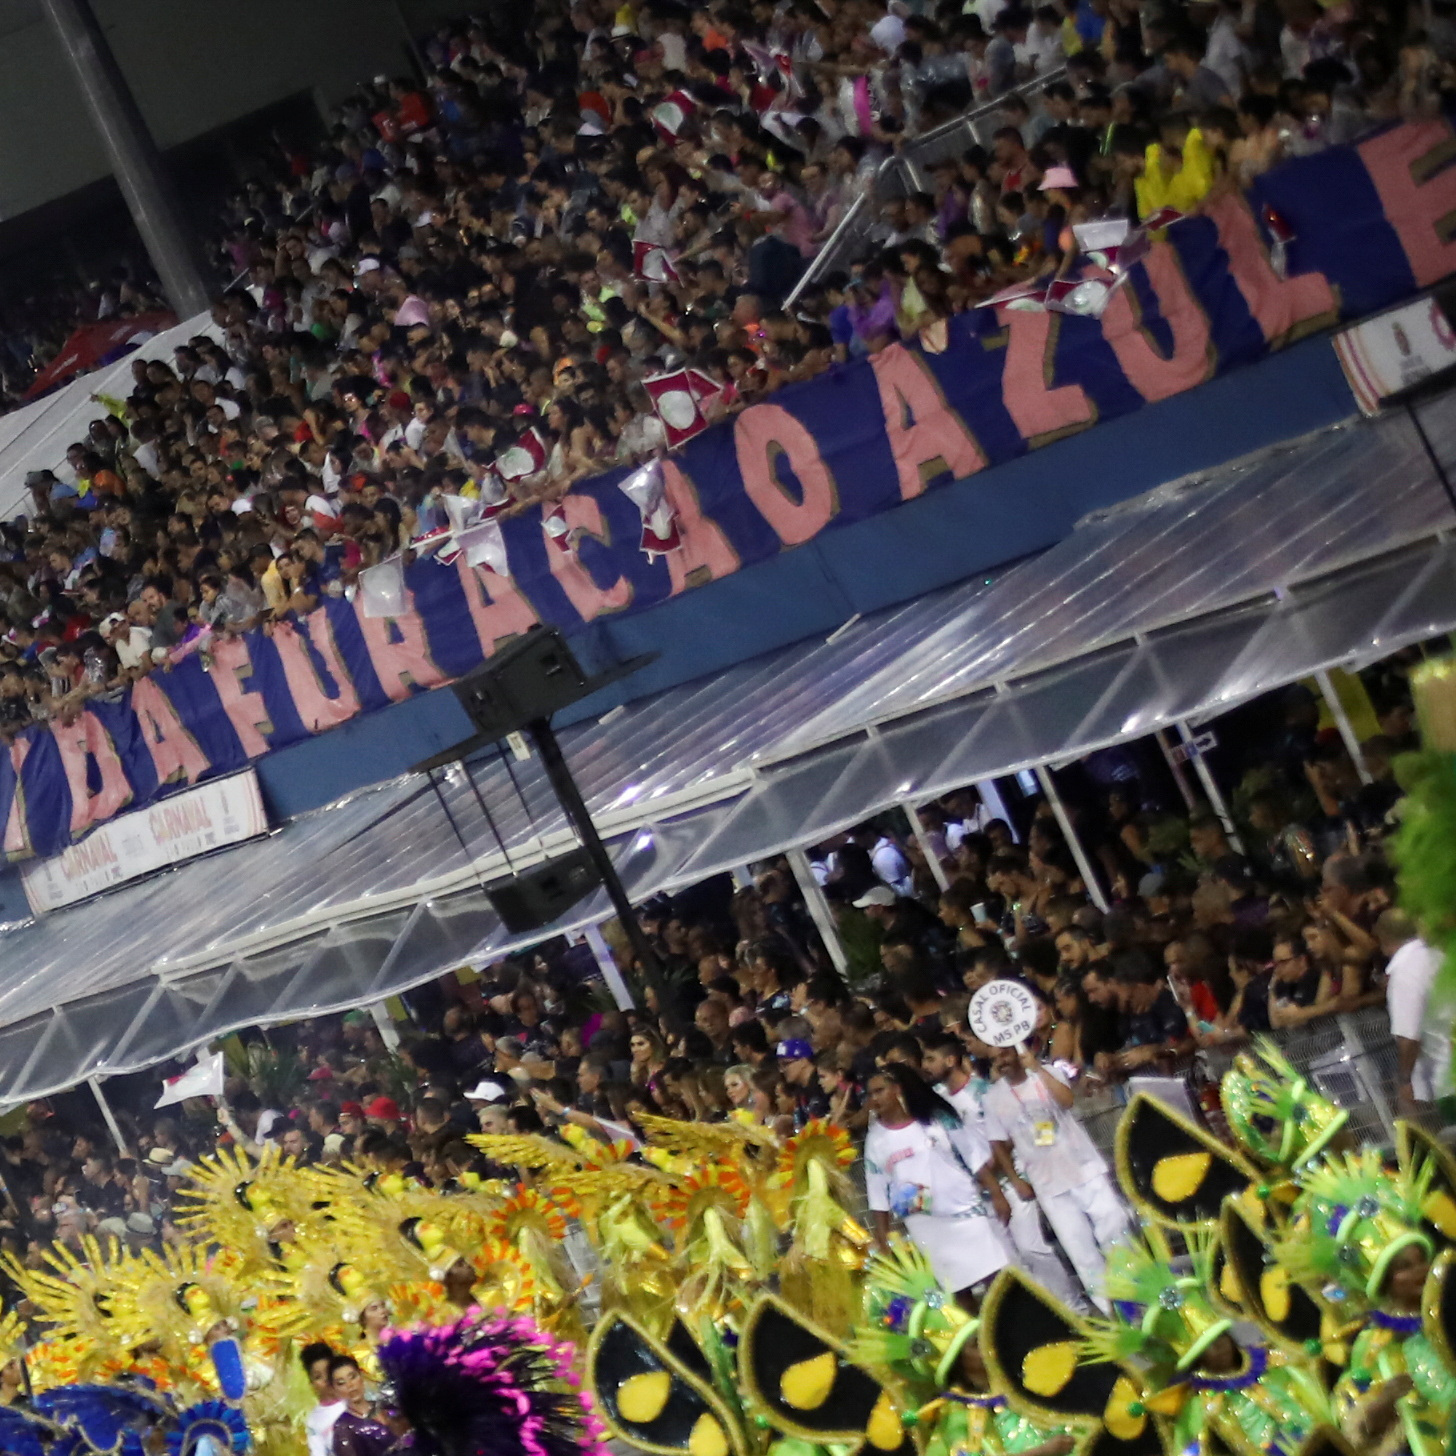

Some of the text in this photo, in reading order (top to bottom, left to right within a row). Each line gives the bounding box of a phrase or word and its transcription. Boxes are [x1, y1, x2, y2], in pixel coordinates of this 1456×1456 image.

[972, 984, 1031, 1033] CASAL OFICIAL
[993, 1020, 1030, 1045] MS PB
